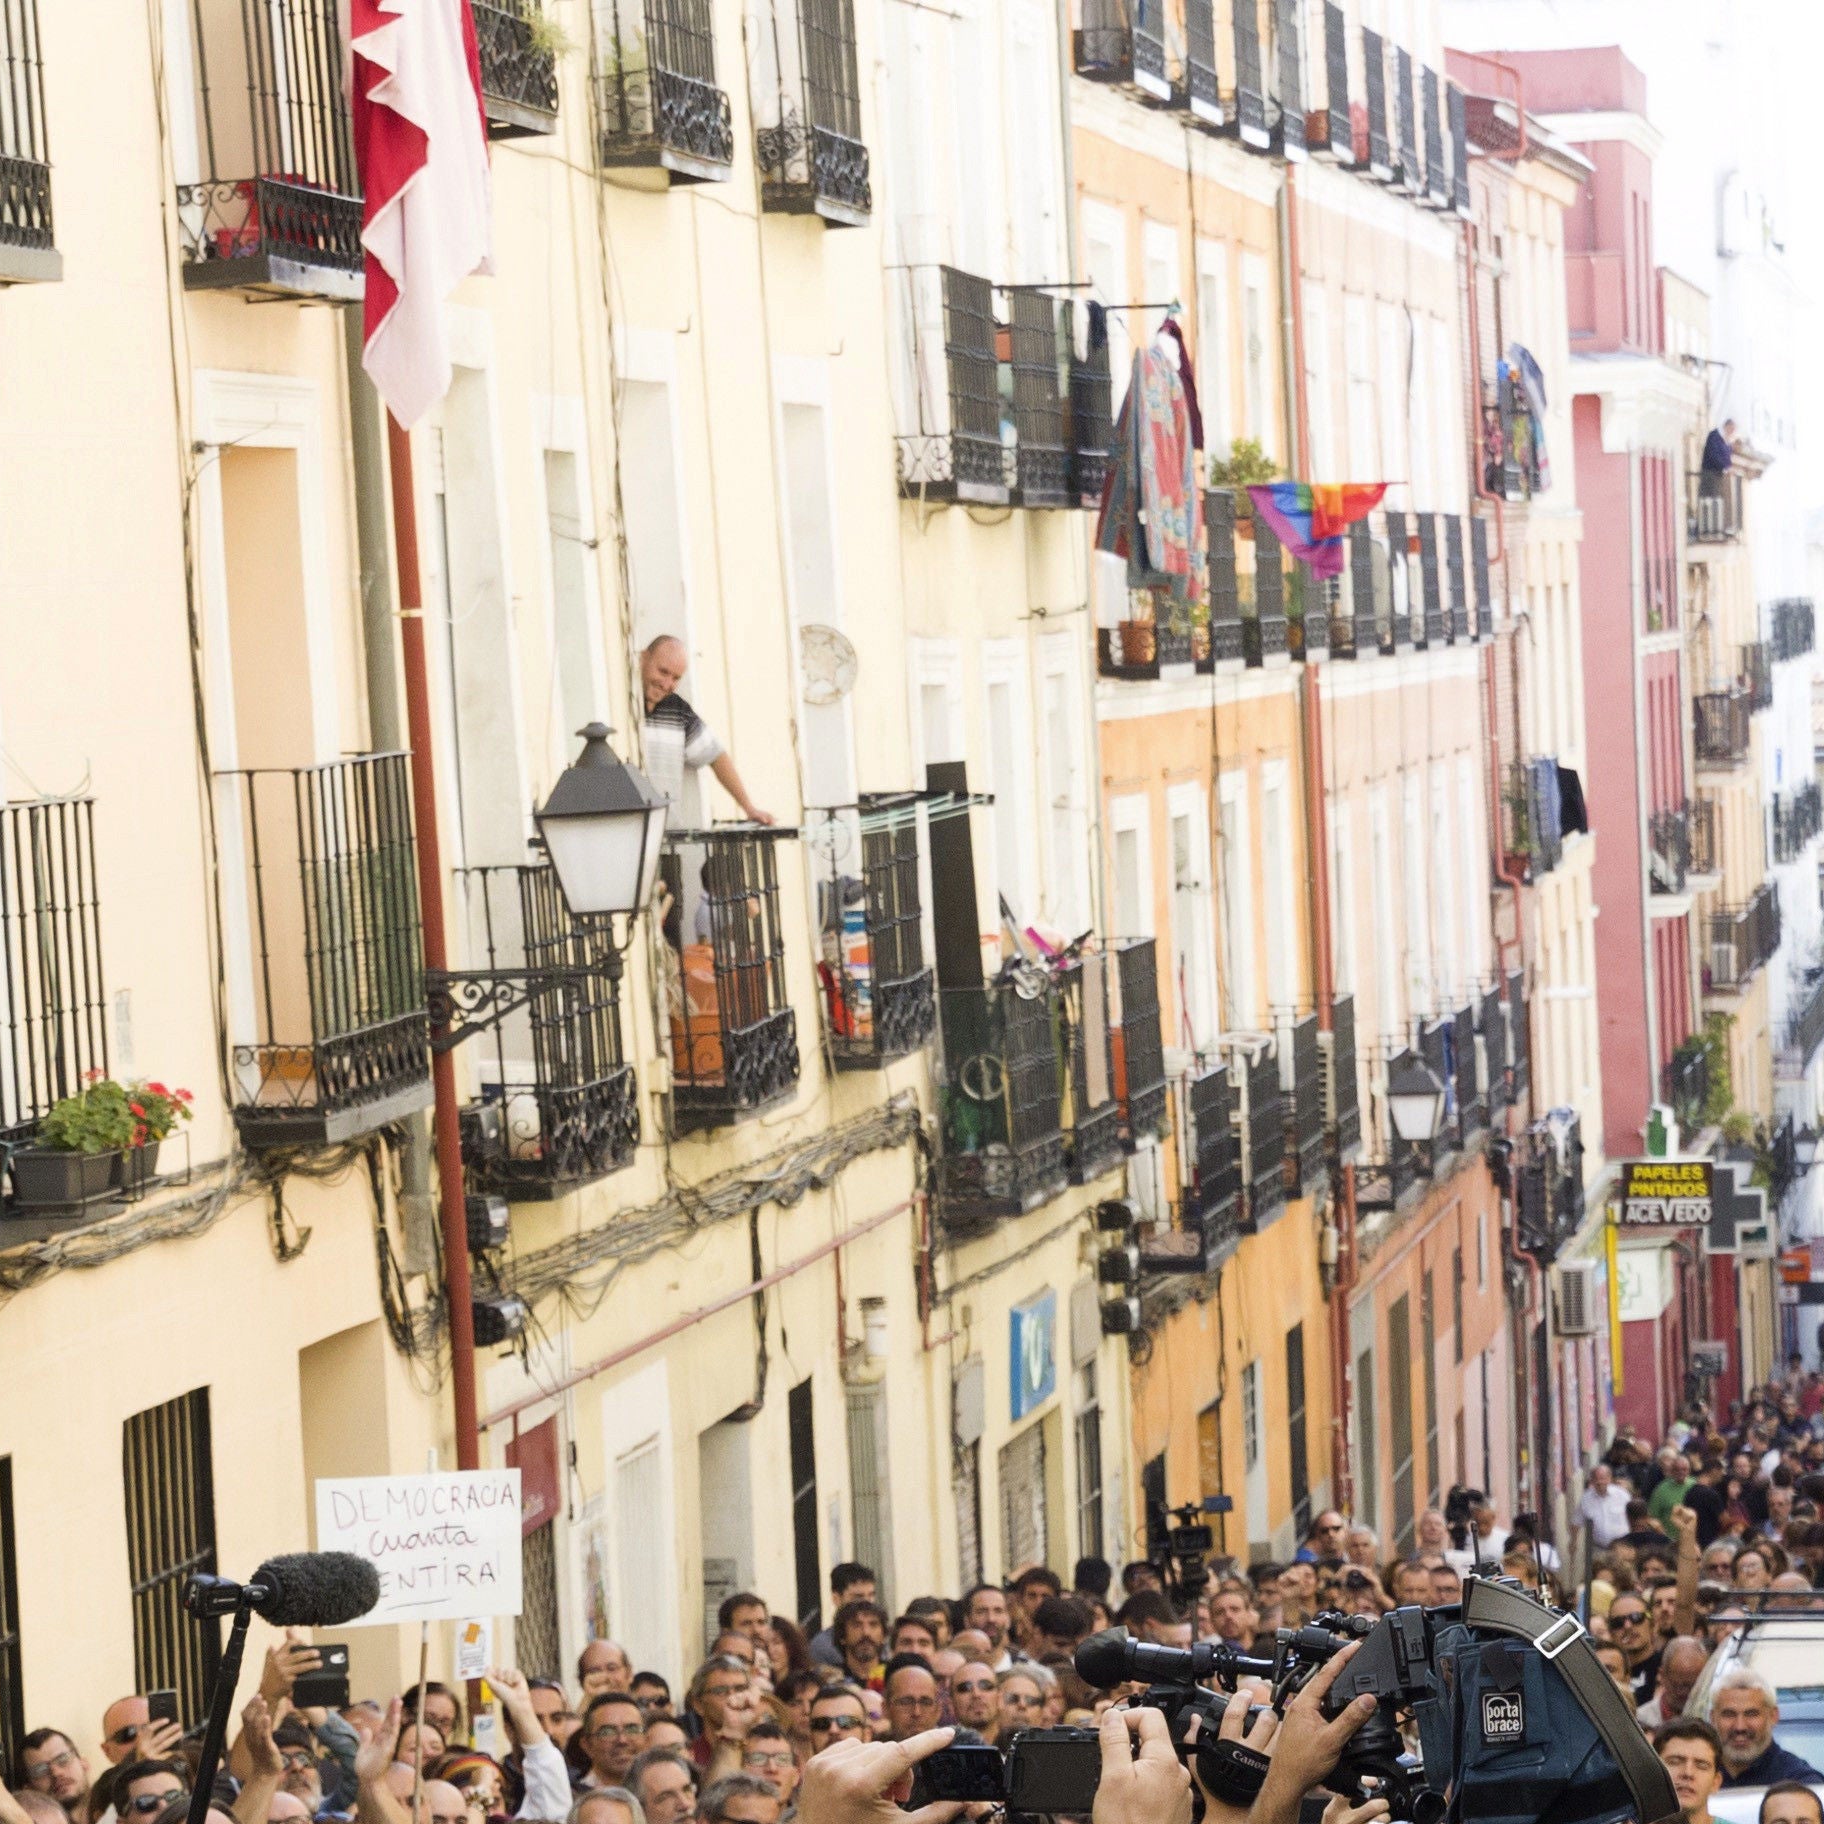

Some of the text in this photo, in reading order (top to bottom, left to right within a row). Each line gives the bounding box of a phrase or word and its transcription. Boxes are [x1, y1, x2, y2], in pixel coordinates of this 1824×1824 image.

[1633, 1163, 1704, 1180] PAPELES
[1628, 1181, 1708, 1197] PINTADOS
[1625, 1197, 1712, 1223] ACEVEDO
[1487, 1702, 1519, 1718] porta
[1487, 1718, 1520, 1733] brace
[1232, 1750, 1269, 1771] Canon
